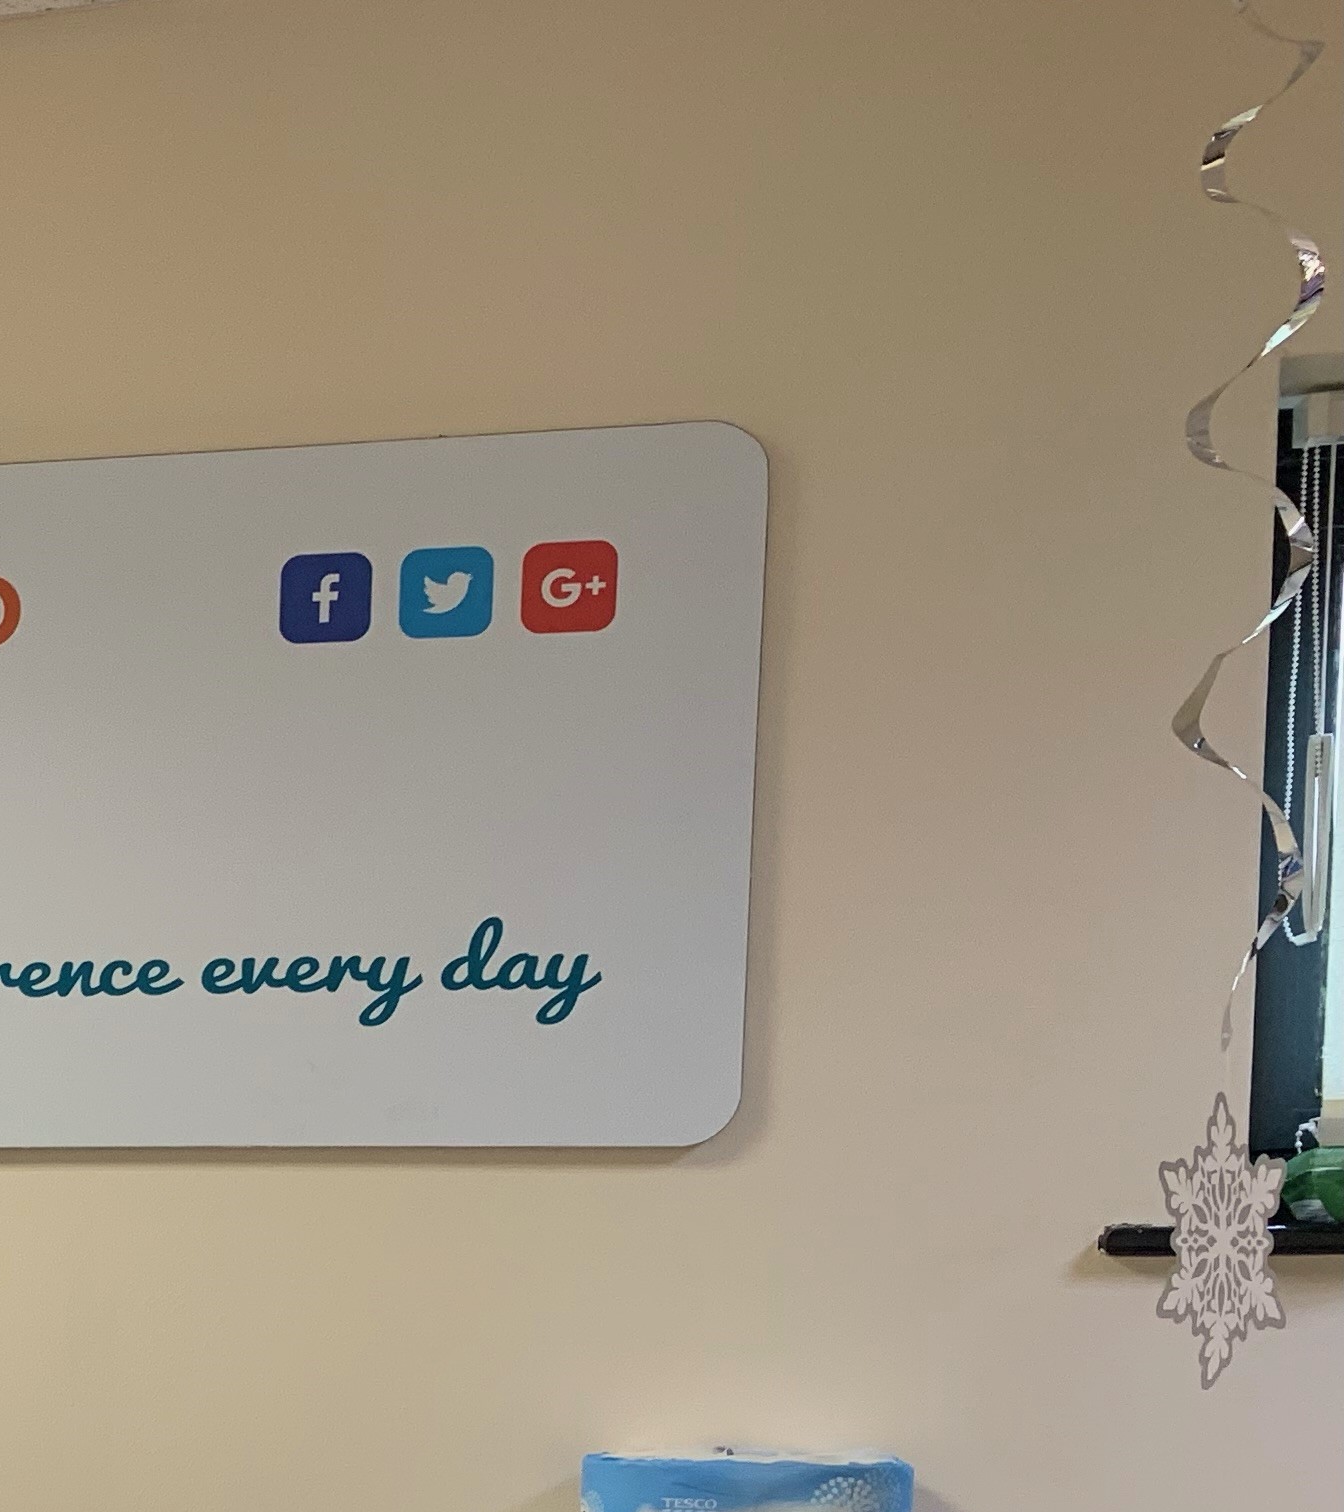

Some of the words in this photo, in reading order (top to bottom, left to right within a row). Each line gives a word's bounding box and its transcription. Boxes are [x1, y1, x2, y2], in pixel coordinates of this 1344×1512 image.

[202, 952, 421, 1031] every
[449, 921, 603, 1031] day
[662, 1498, 717, 1509] TESCO
